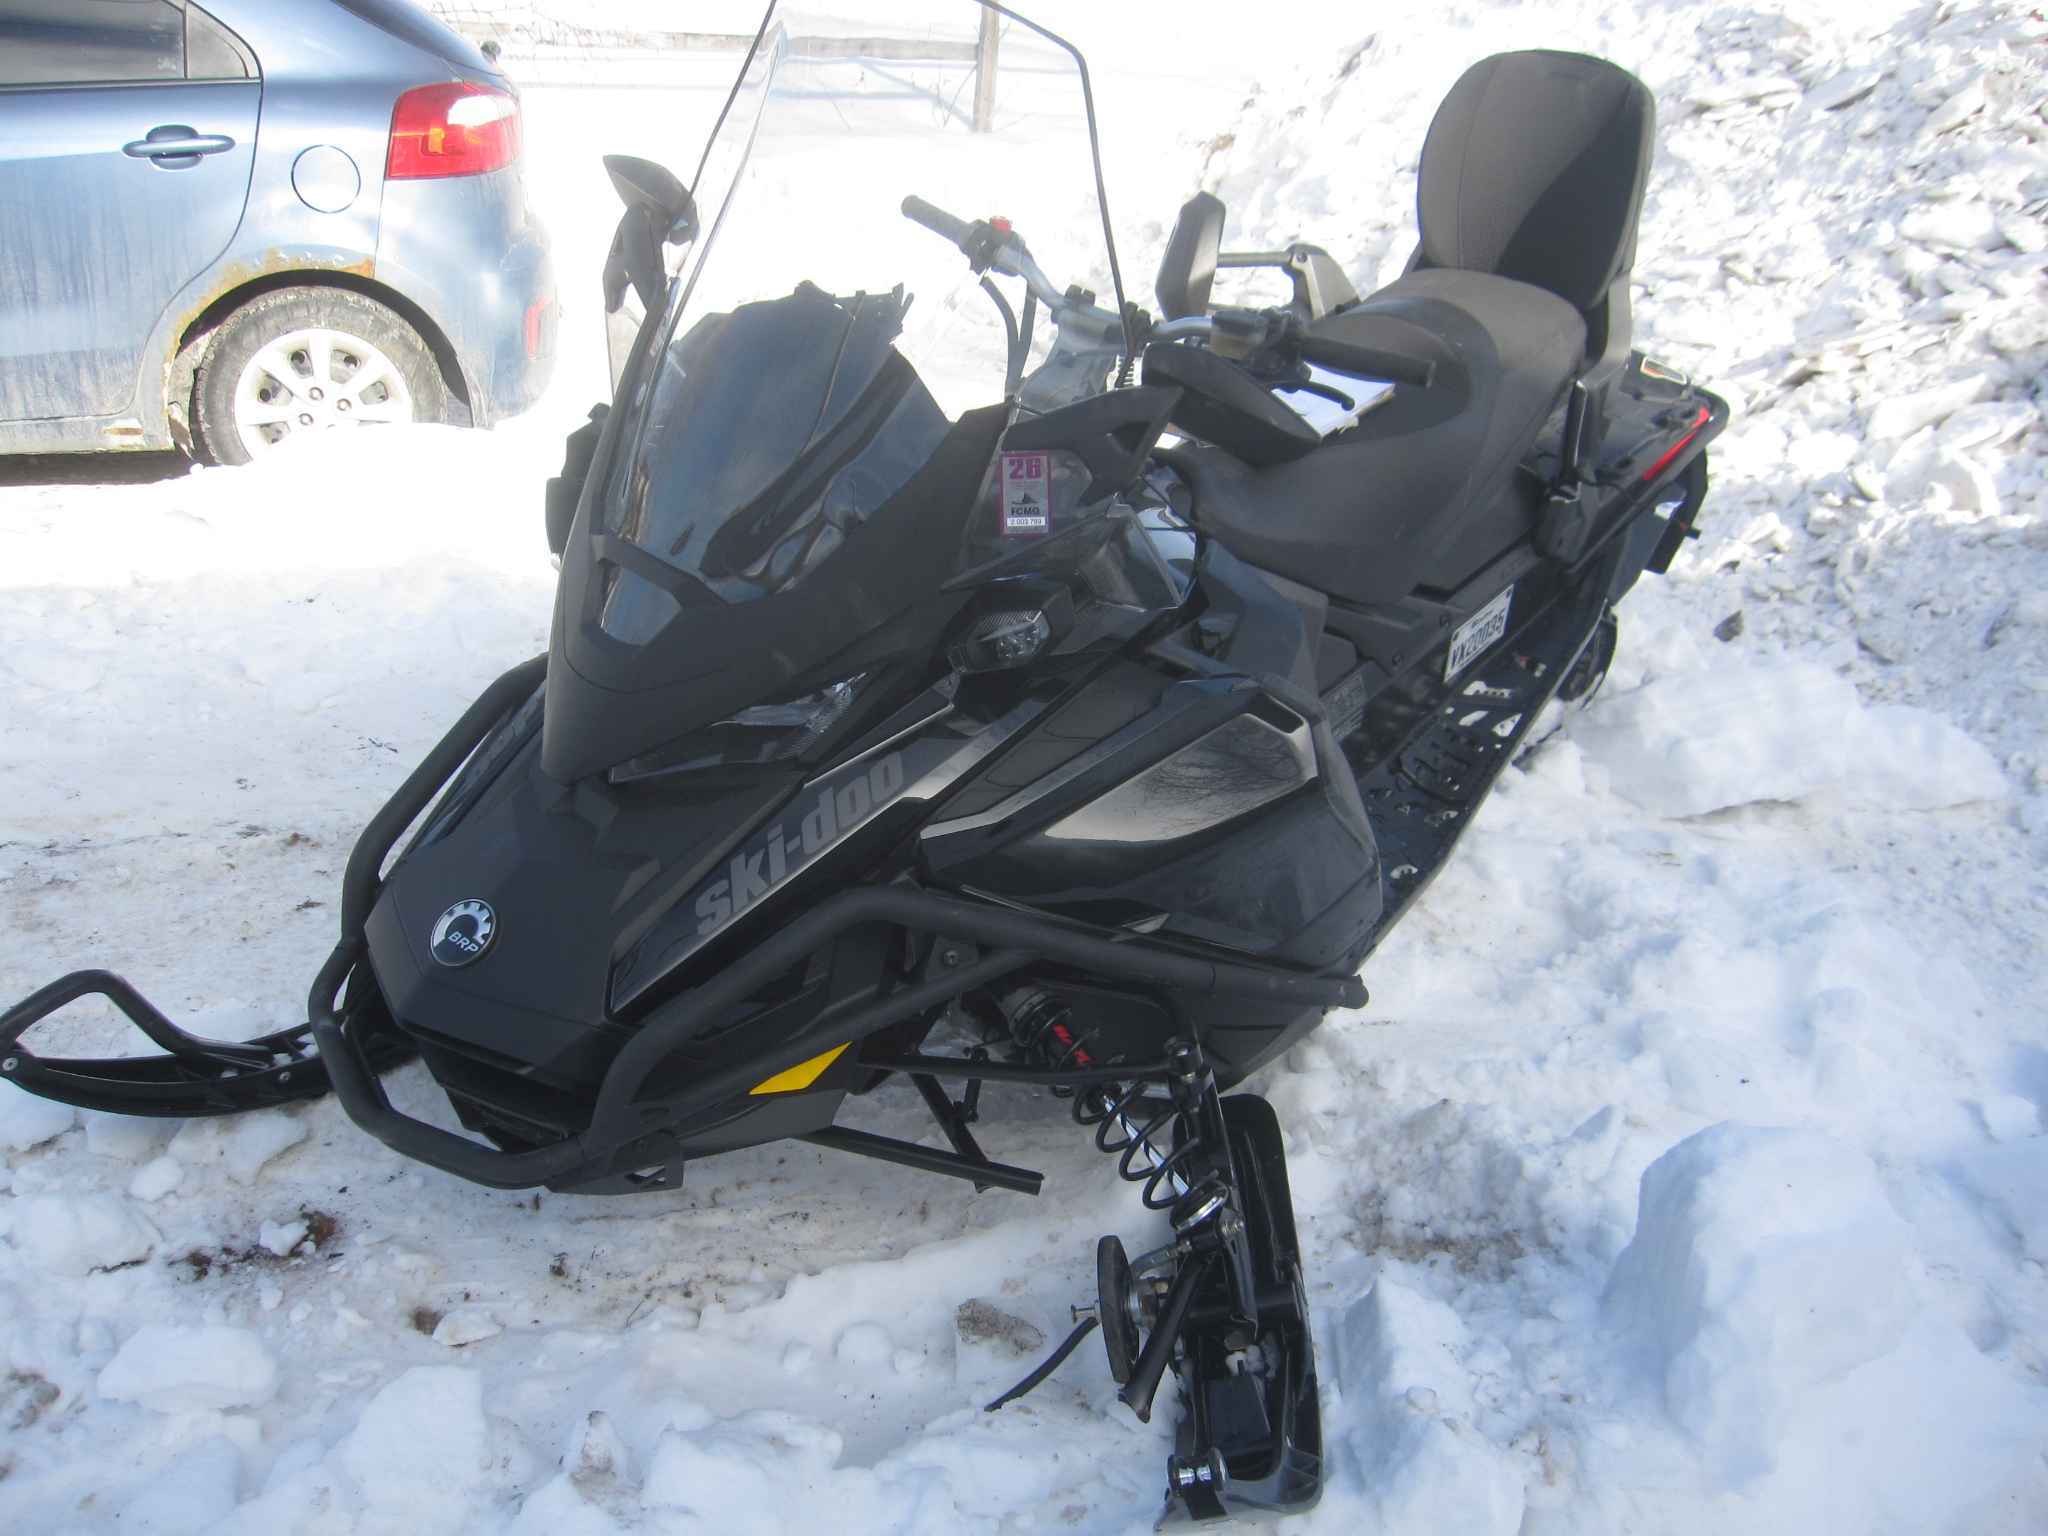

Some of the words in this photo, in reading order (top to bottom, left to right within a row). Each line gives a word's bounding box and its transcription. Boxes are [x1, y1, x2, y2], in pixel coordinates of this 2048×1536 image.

[1008, 459, 1041, 480] 26
[695, 751, 904, 935] ski-doo
[447, 931, 479, 952] BRP
